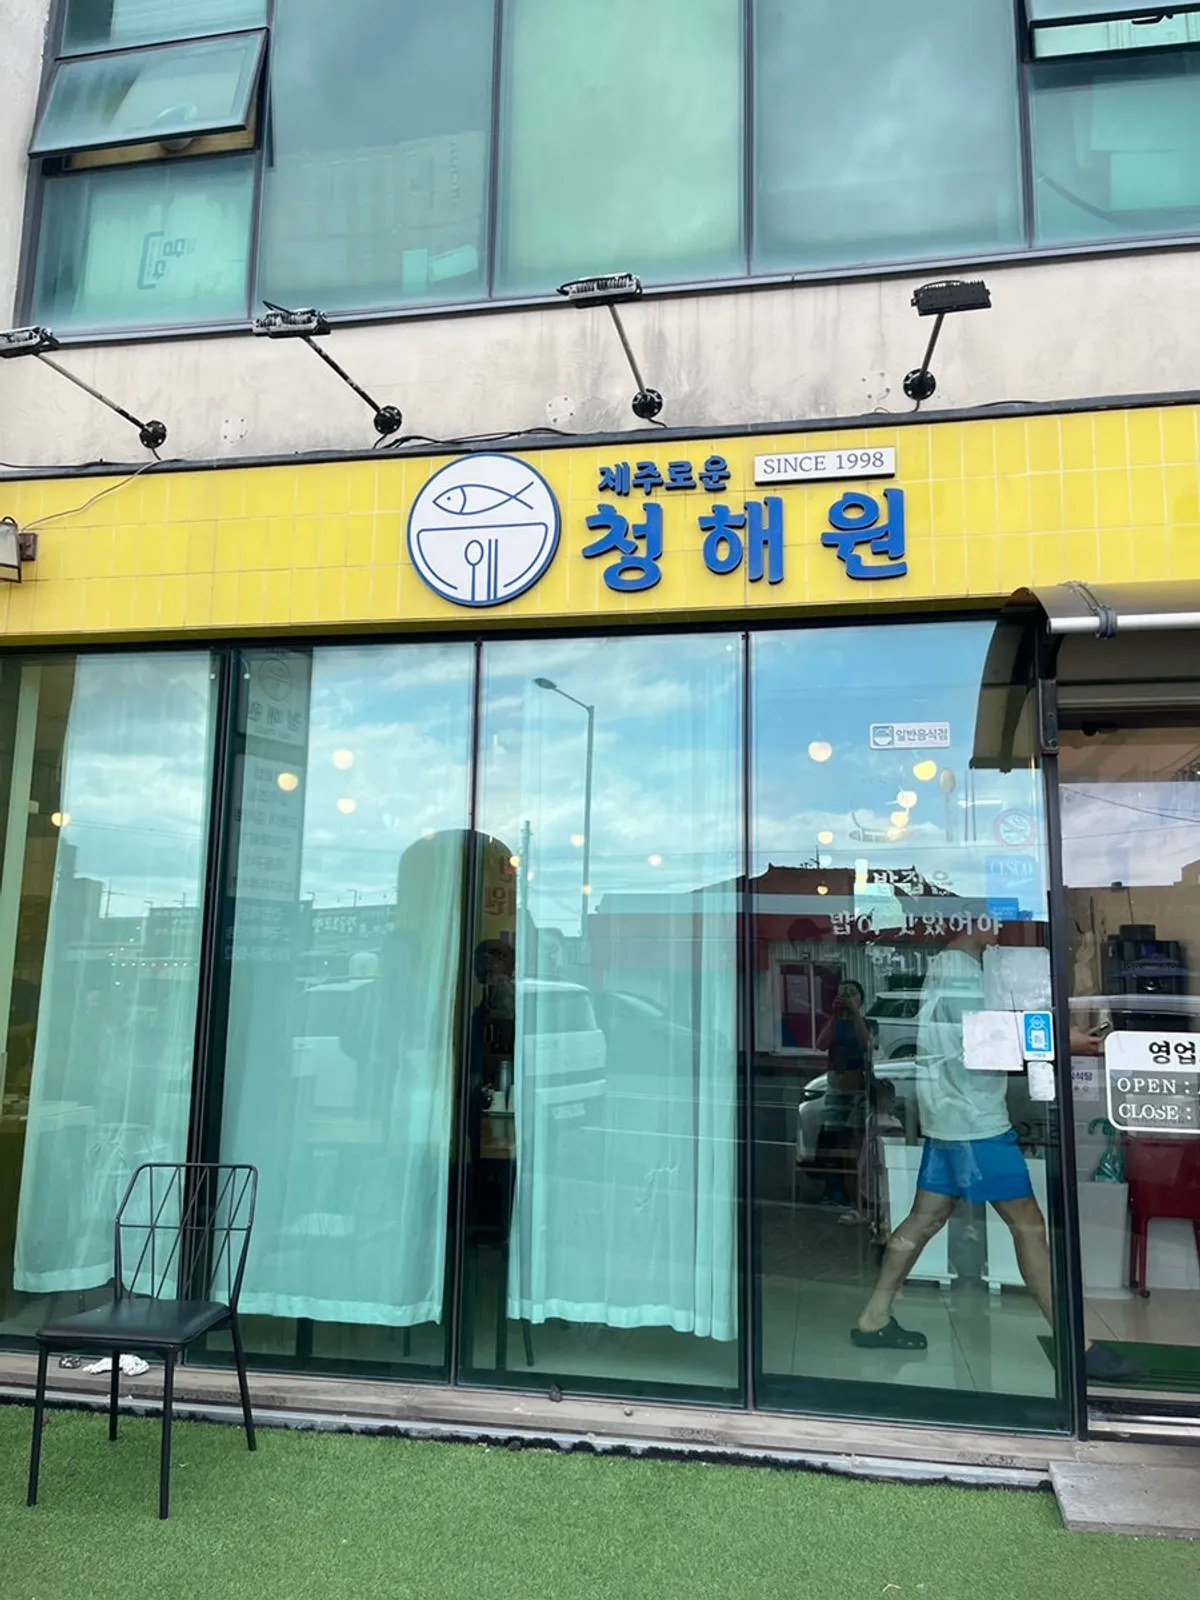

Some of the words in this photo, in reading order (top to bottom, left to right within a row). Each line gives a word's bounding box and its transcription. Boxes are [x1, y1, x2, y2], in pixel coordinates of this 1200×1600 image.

[598, 456, 730, 494] 제주로운
[763, 455, 826, 475] SINCE
[836, 451, 884, 470] 1998
[582, 488, 909, 593] 청해원
[896, 727, 948, 741] 일반음식점
[1149, 1041, 1196, 1065] 영업
[1117, 1078, 1176, 1094] OPEN
[1119, 1104, 1178, 1120] CLOSE
